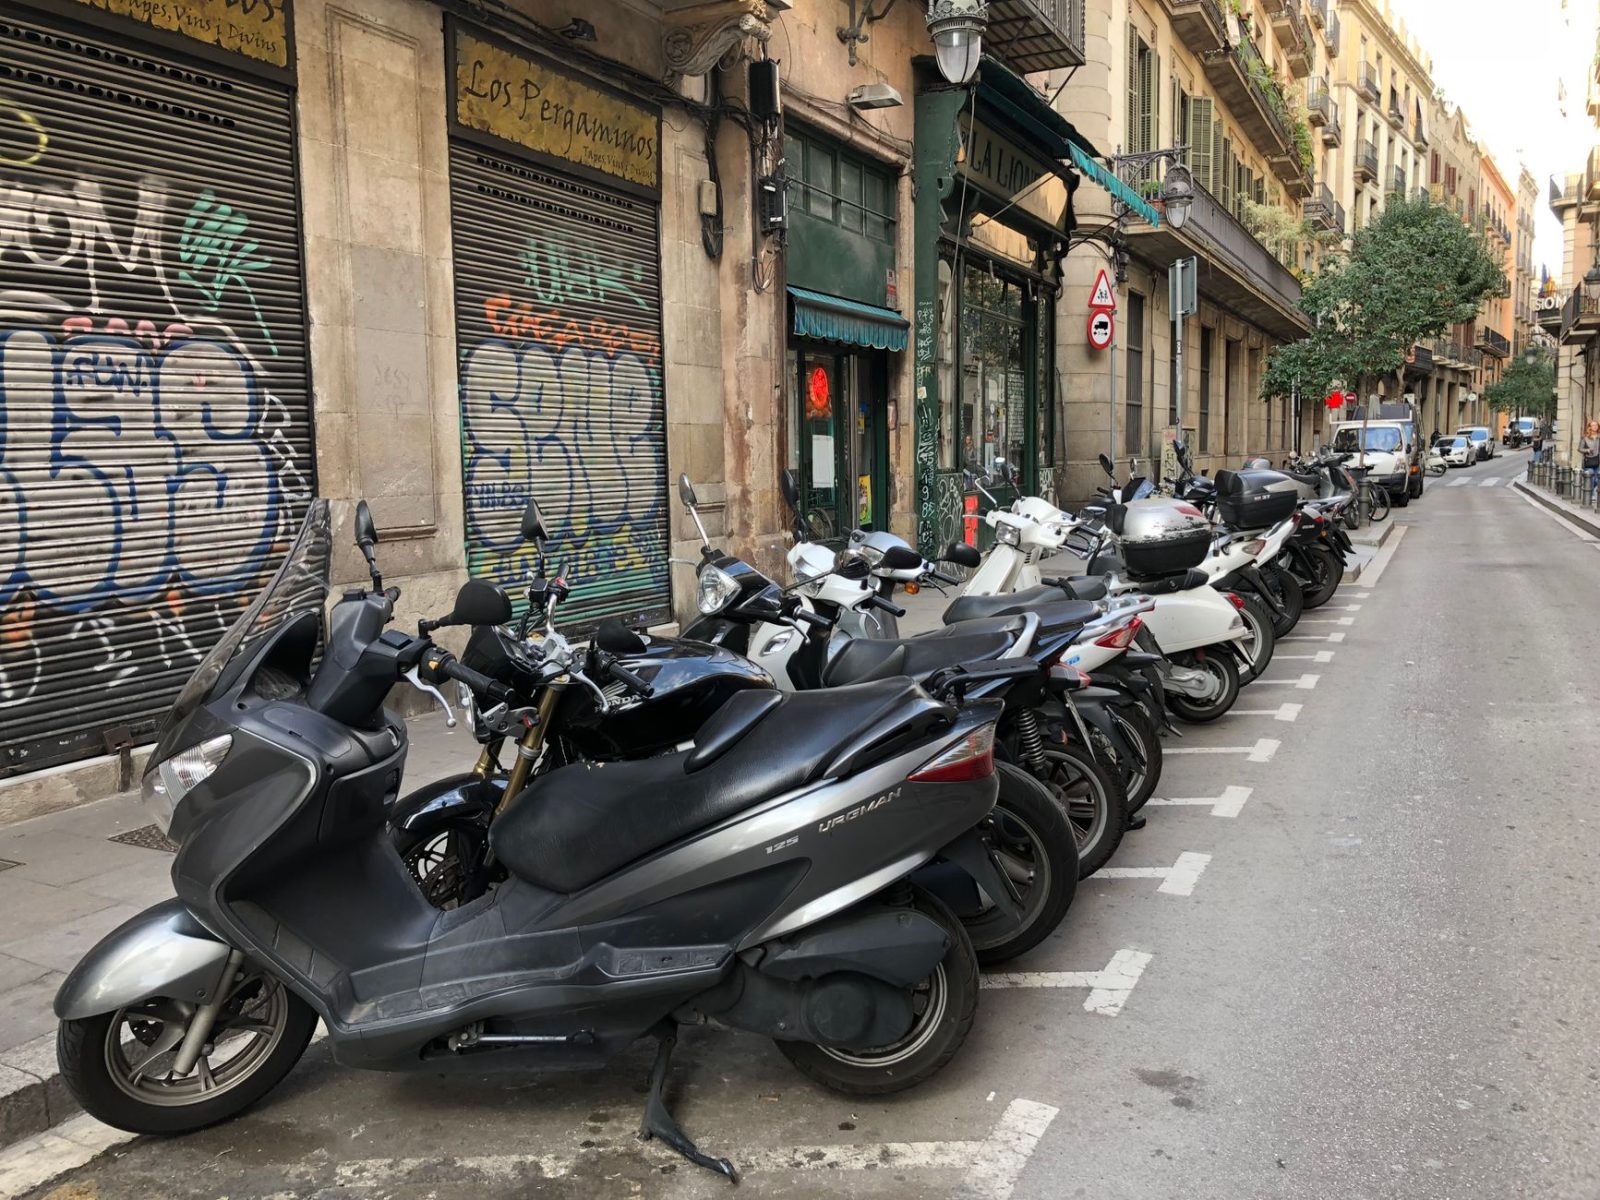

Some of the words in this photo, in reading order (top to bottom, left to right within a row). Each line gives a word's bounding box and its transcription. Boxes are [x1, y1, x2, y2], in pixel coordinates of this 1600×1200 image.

[174, 5, 211, 31] Vins
[229, 23, 277, 53] Divins
[465, 60, 511, 107] Los
[519, 79, 652, 160] Pergaminos
[970, 131, 992, 179] LA
[765, 835, 799, 854] 125
